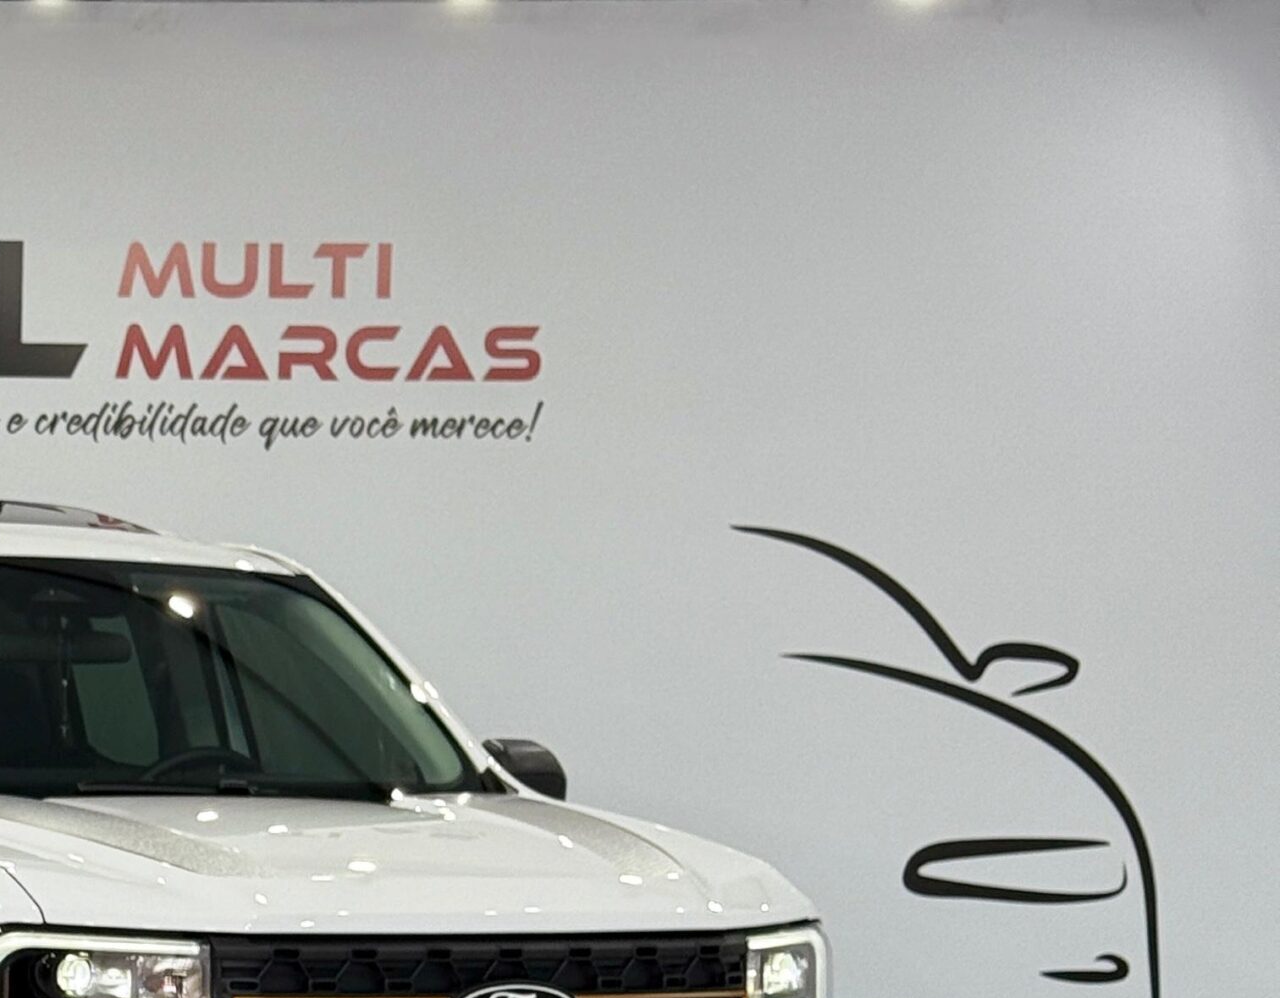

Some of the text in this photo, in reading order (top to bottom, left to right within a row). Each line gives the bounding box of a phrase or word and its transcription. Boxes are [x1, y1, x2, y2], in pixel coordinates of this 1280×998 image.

[117, 241, 394, 299] MULTI
[115, 323, 543, 382] MARCAS
[6, 413, 28, 434] e
[34, 400, 252, 445] credibilidade
[258, 414, 323, 451] que
[329, 406, 403, 439] você
[410, 400, 545, 442] merece!
